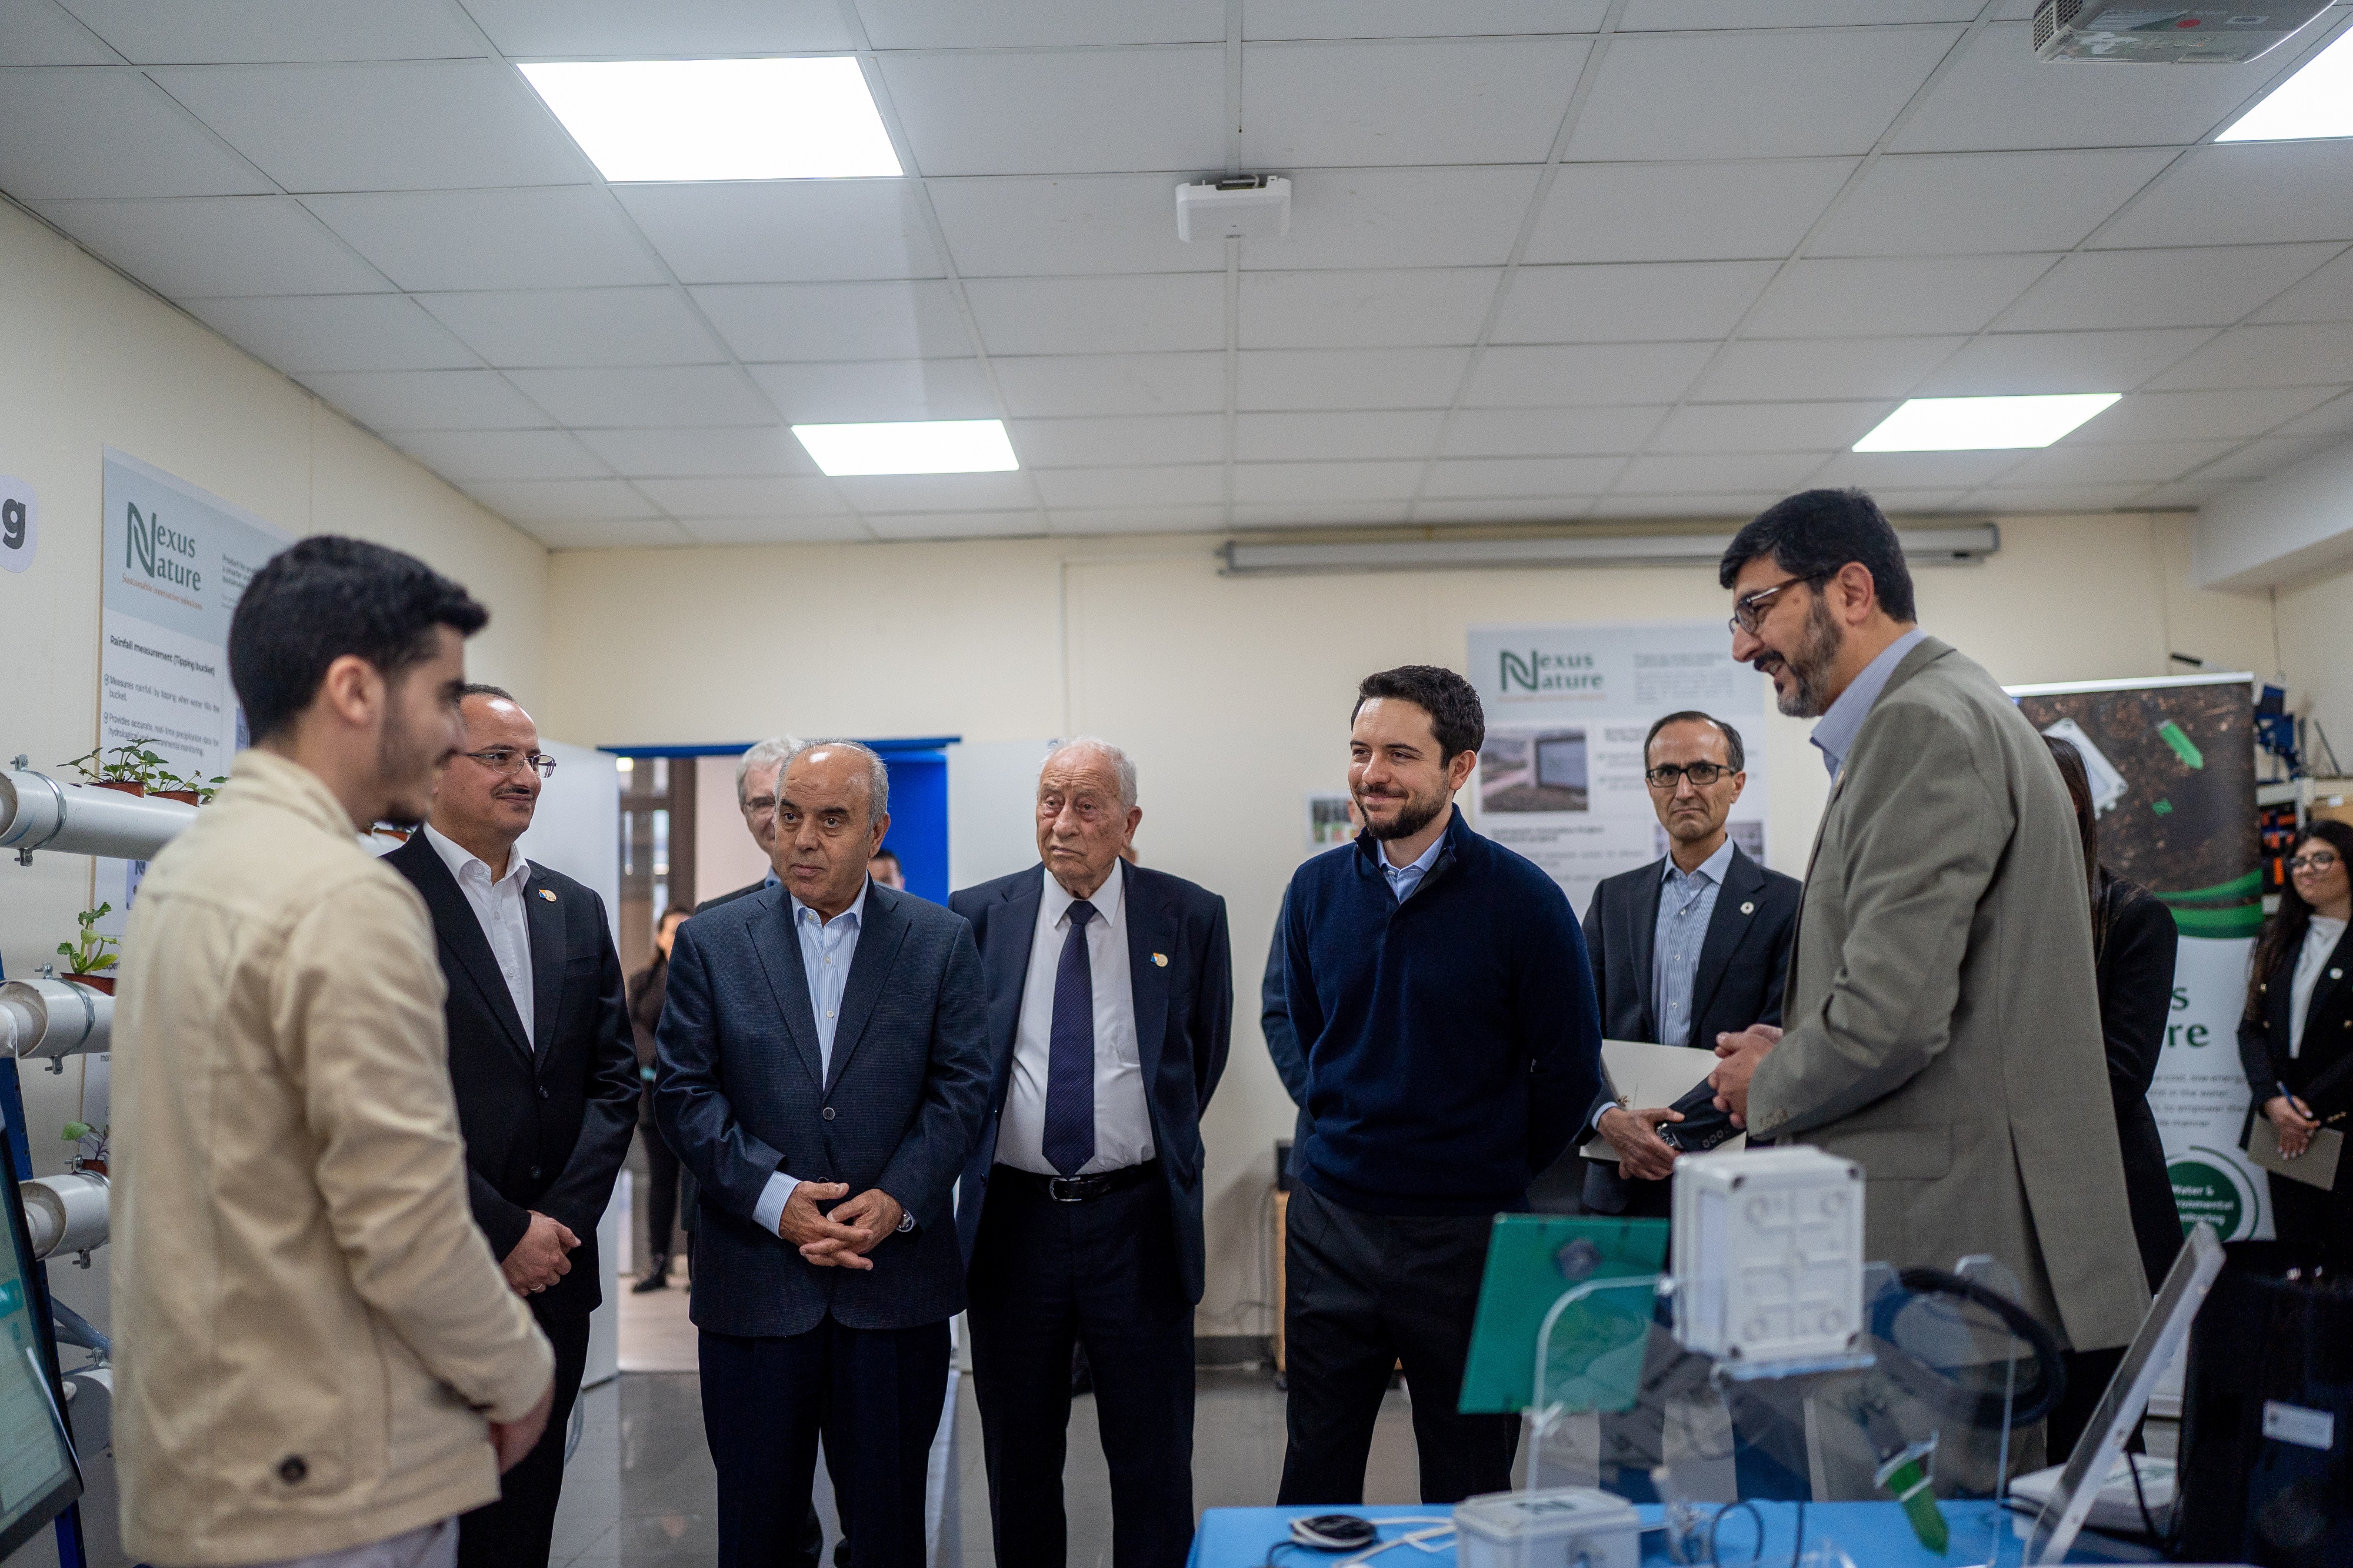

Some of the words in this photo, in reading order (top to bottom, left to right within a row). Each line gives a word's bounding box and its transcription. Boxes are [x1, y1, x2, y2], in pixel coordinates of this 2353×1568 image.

[110, 635, 133, 651] Rainfall
[134, 643, 172, 662] measurement
[109, 675, 134, 690] Measures
